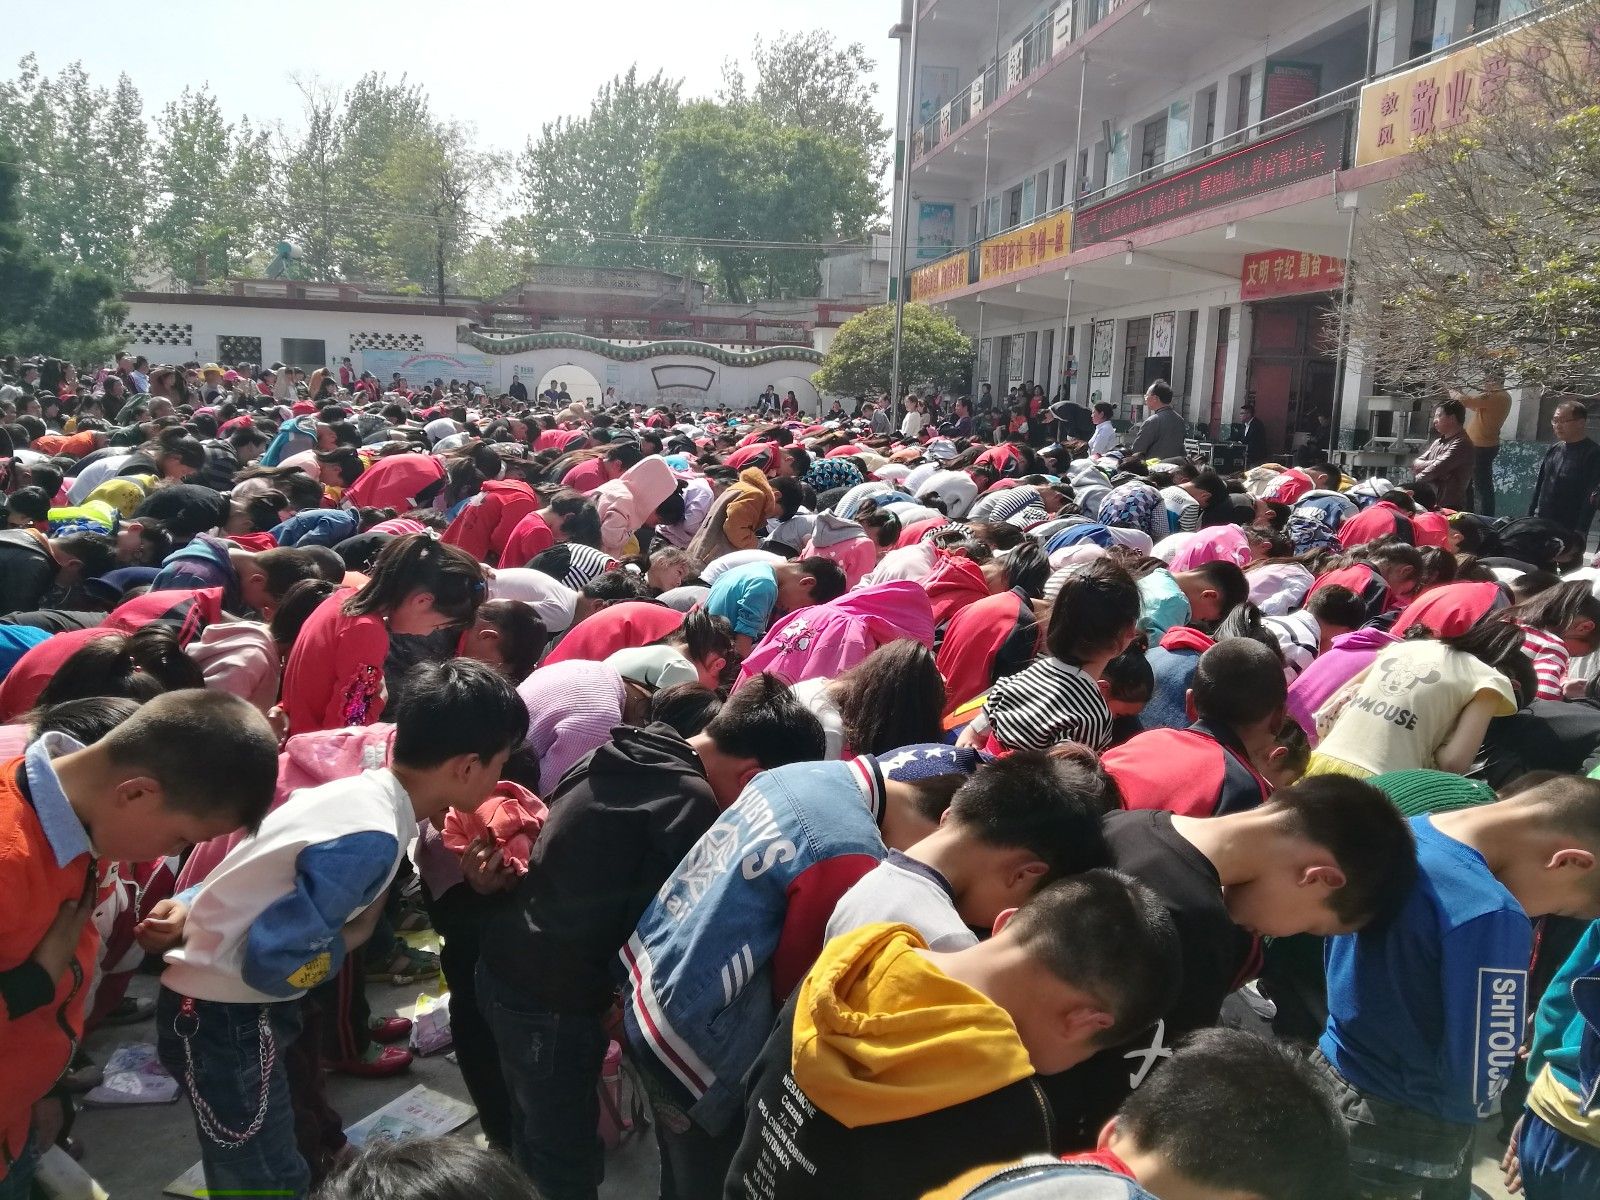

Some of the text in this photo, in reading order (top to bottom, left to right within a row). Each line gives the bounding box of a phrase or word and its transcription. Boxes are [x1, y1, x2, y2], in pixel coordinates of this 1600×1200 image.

[1376, 91, 1400, 148] 教风
[1246, 259, 1269, 287] 文明
[1273, 255, 1295, 282] 守纪
